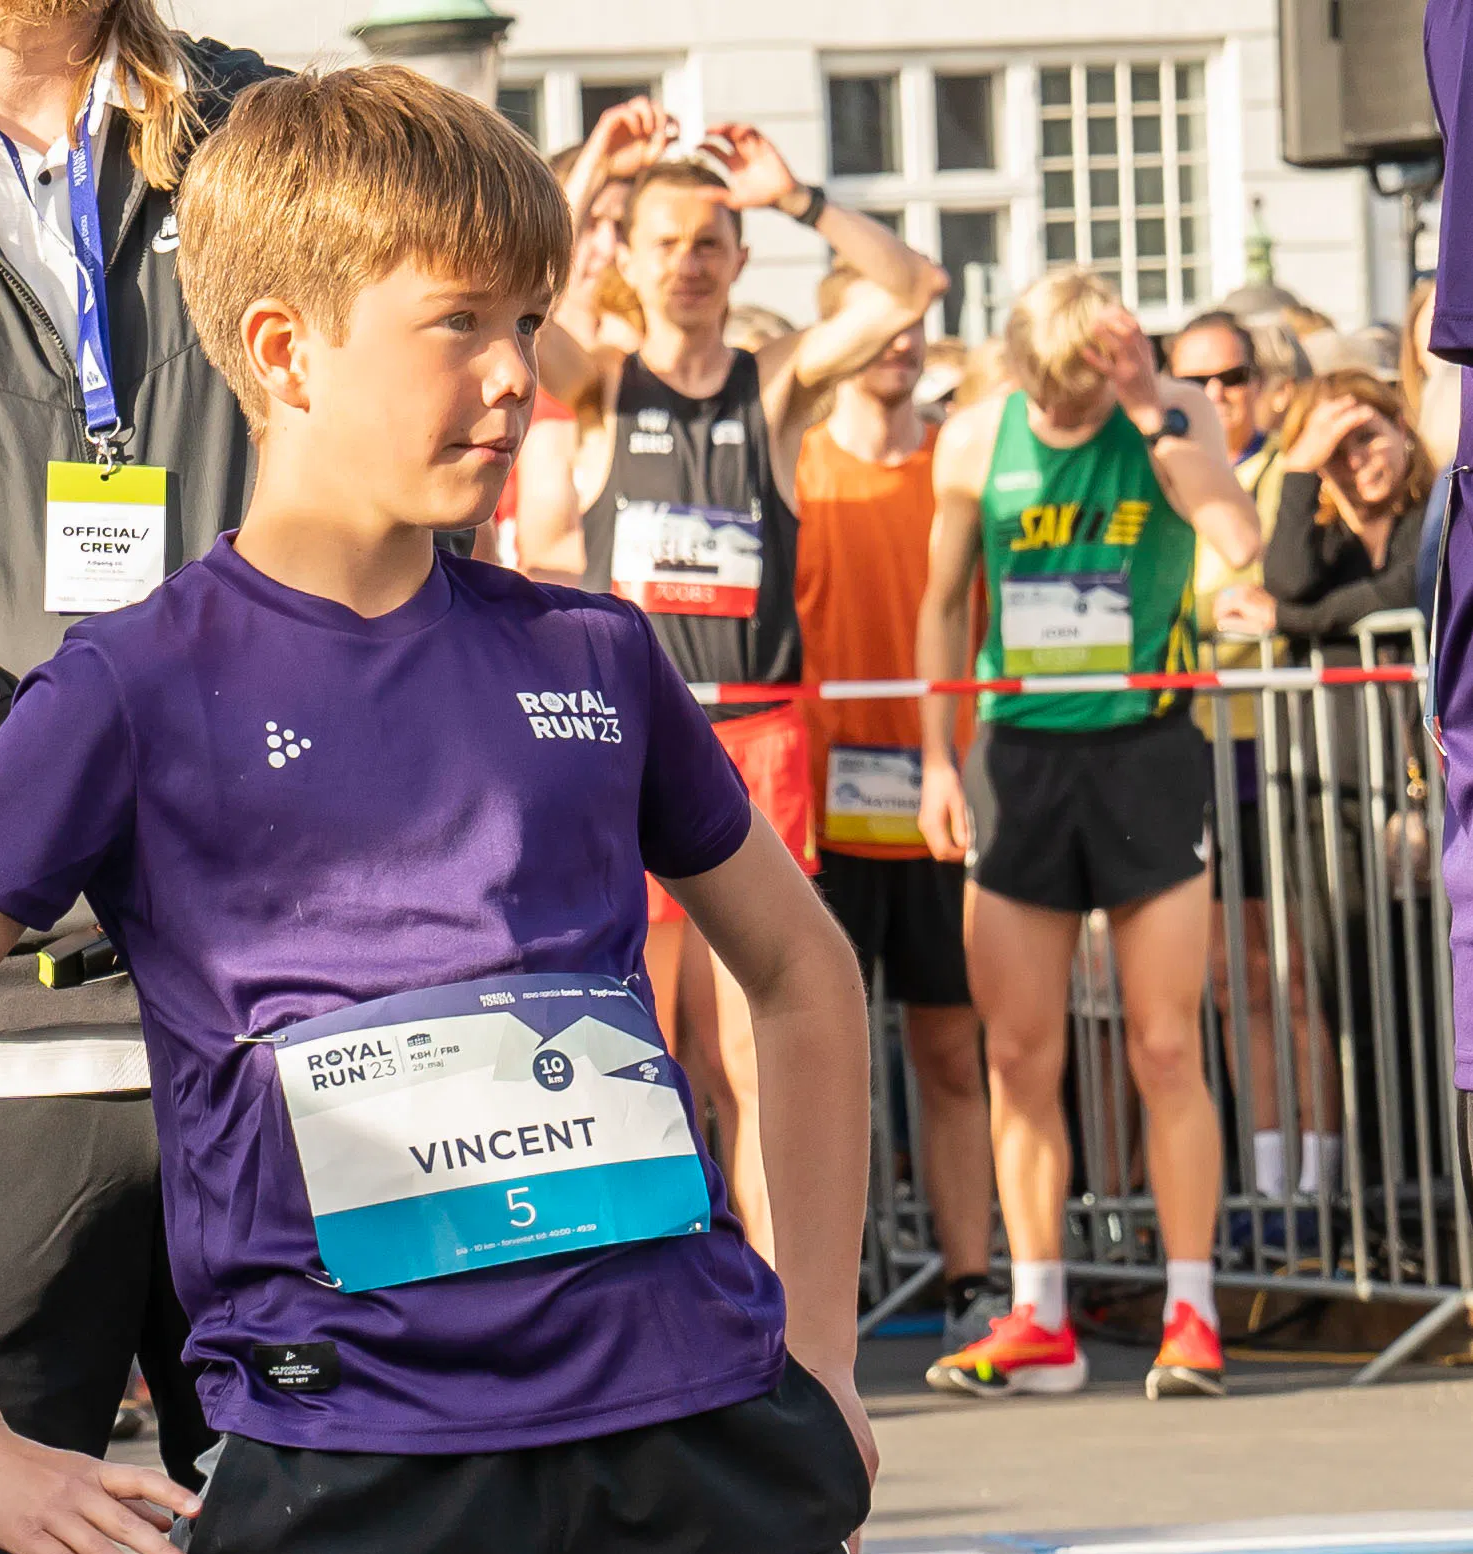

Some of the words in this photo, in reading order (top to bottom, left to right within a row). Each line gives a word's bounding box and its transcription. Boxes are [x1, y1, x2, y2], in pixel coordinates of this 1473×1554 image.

[62, 526, 150, 541] OFFICIAL/
[80, 542, 131, 554] CREW
[516, 690, 617, 715] ROYAL
[307, 1040, 392, 1071] ROYAL
[410, 1050, 432, 1061] KBH
[440, 1045, 460, 1056] FRB
[538, 1056, 565, 1075] 10
[547, 1074, 564, 1085] km
[409, 1116, 595, 1174] VINCENT
[505, 1186, 537, 1228] 5
